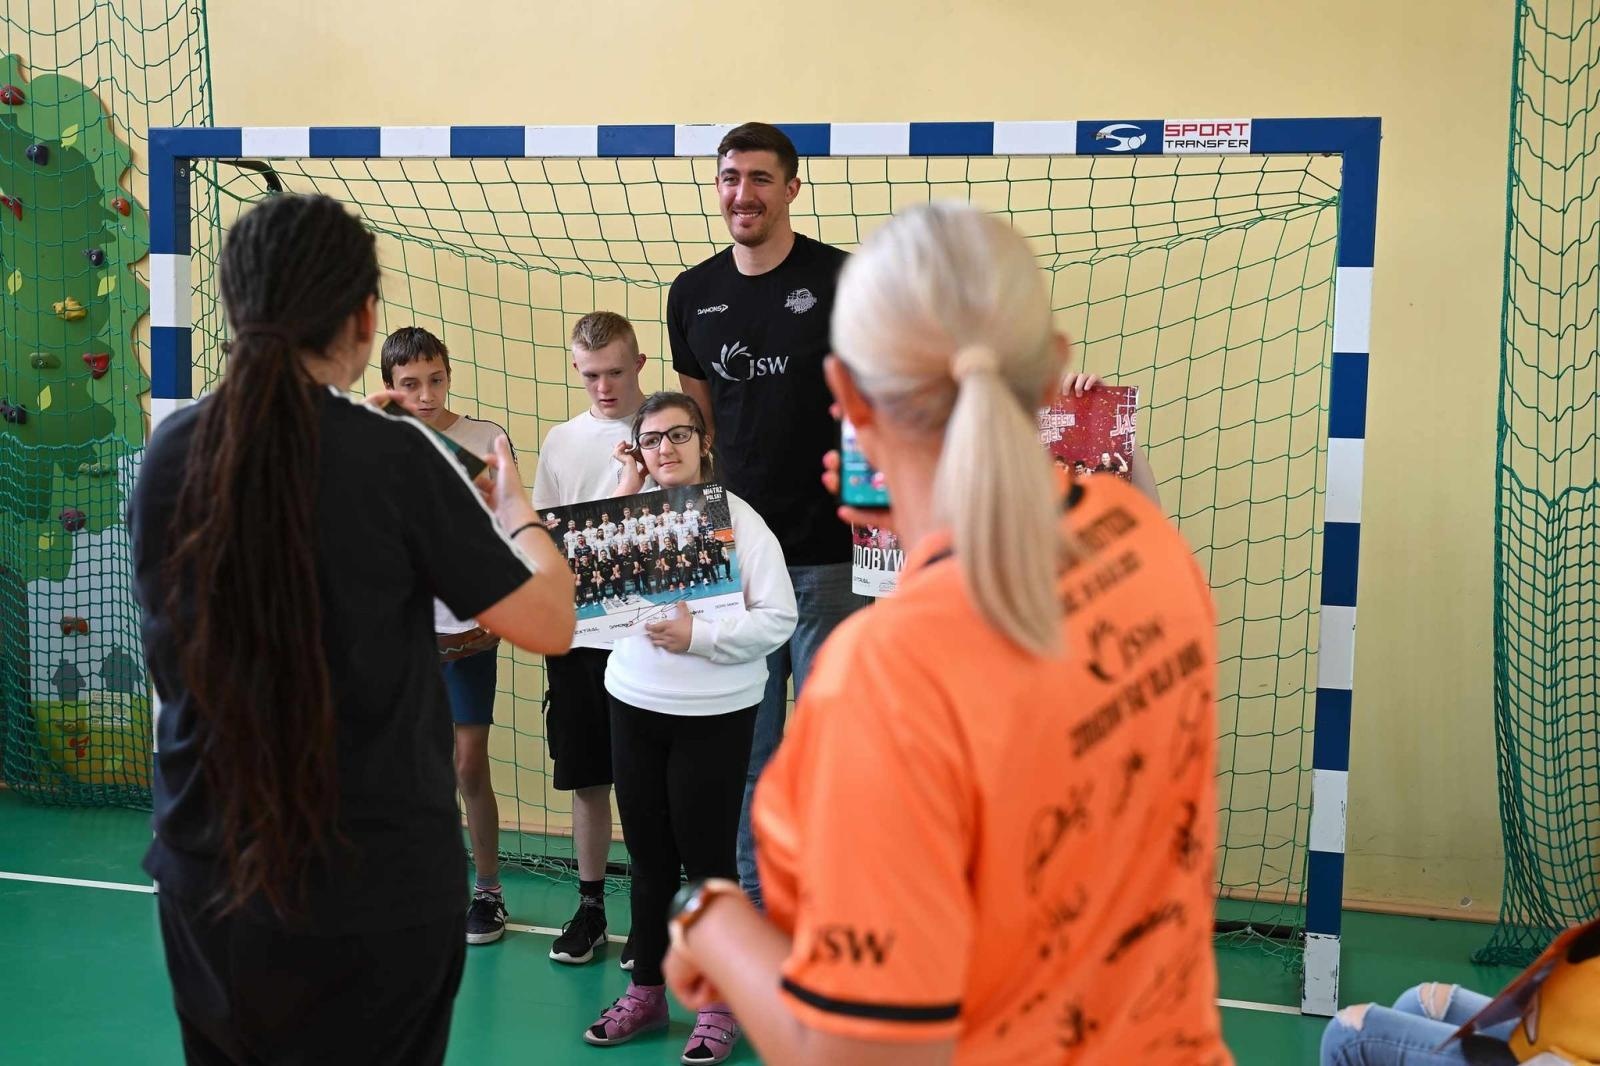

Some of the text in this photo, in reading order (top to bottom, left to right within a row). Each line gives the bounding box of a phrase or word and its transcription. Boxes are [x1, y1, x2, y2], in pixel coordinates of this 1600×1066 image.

[1165, 123, 1249, 137] SPORT
[1165, 139, 1249, 149] TRANSFER
[746, 355, 789, 380] JSW
